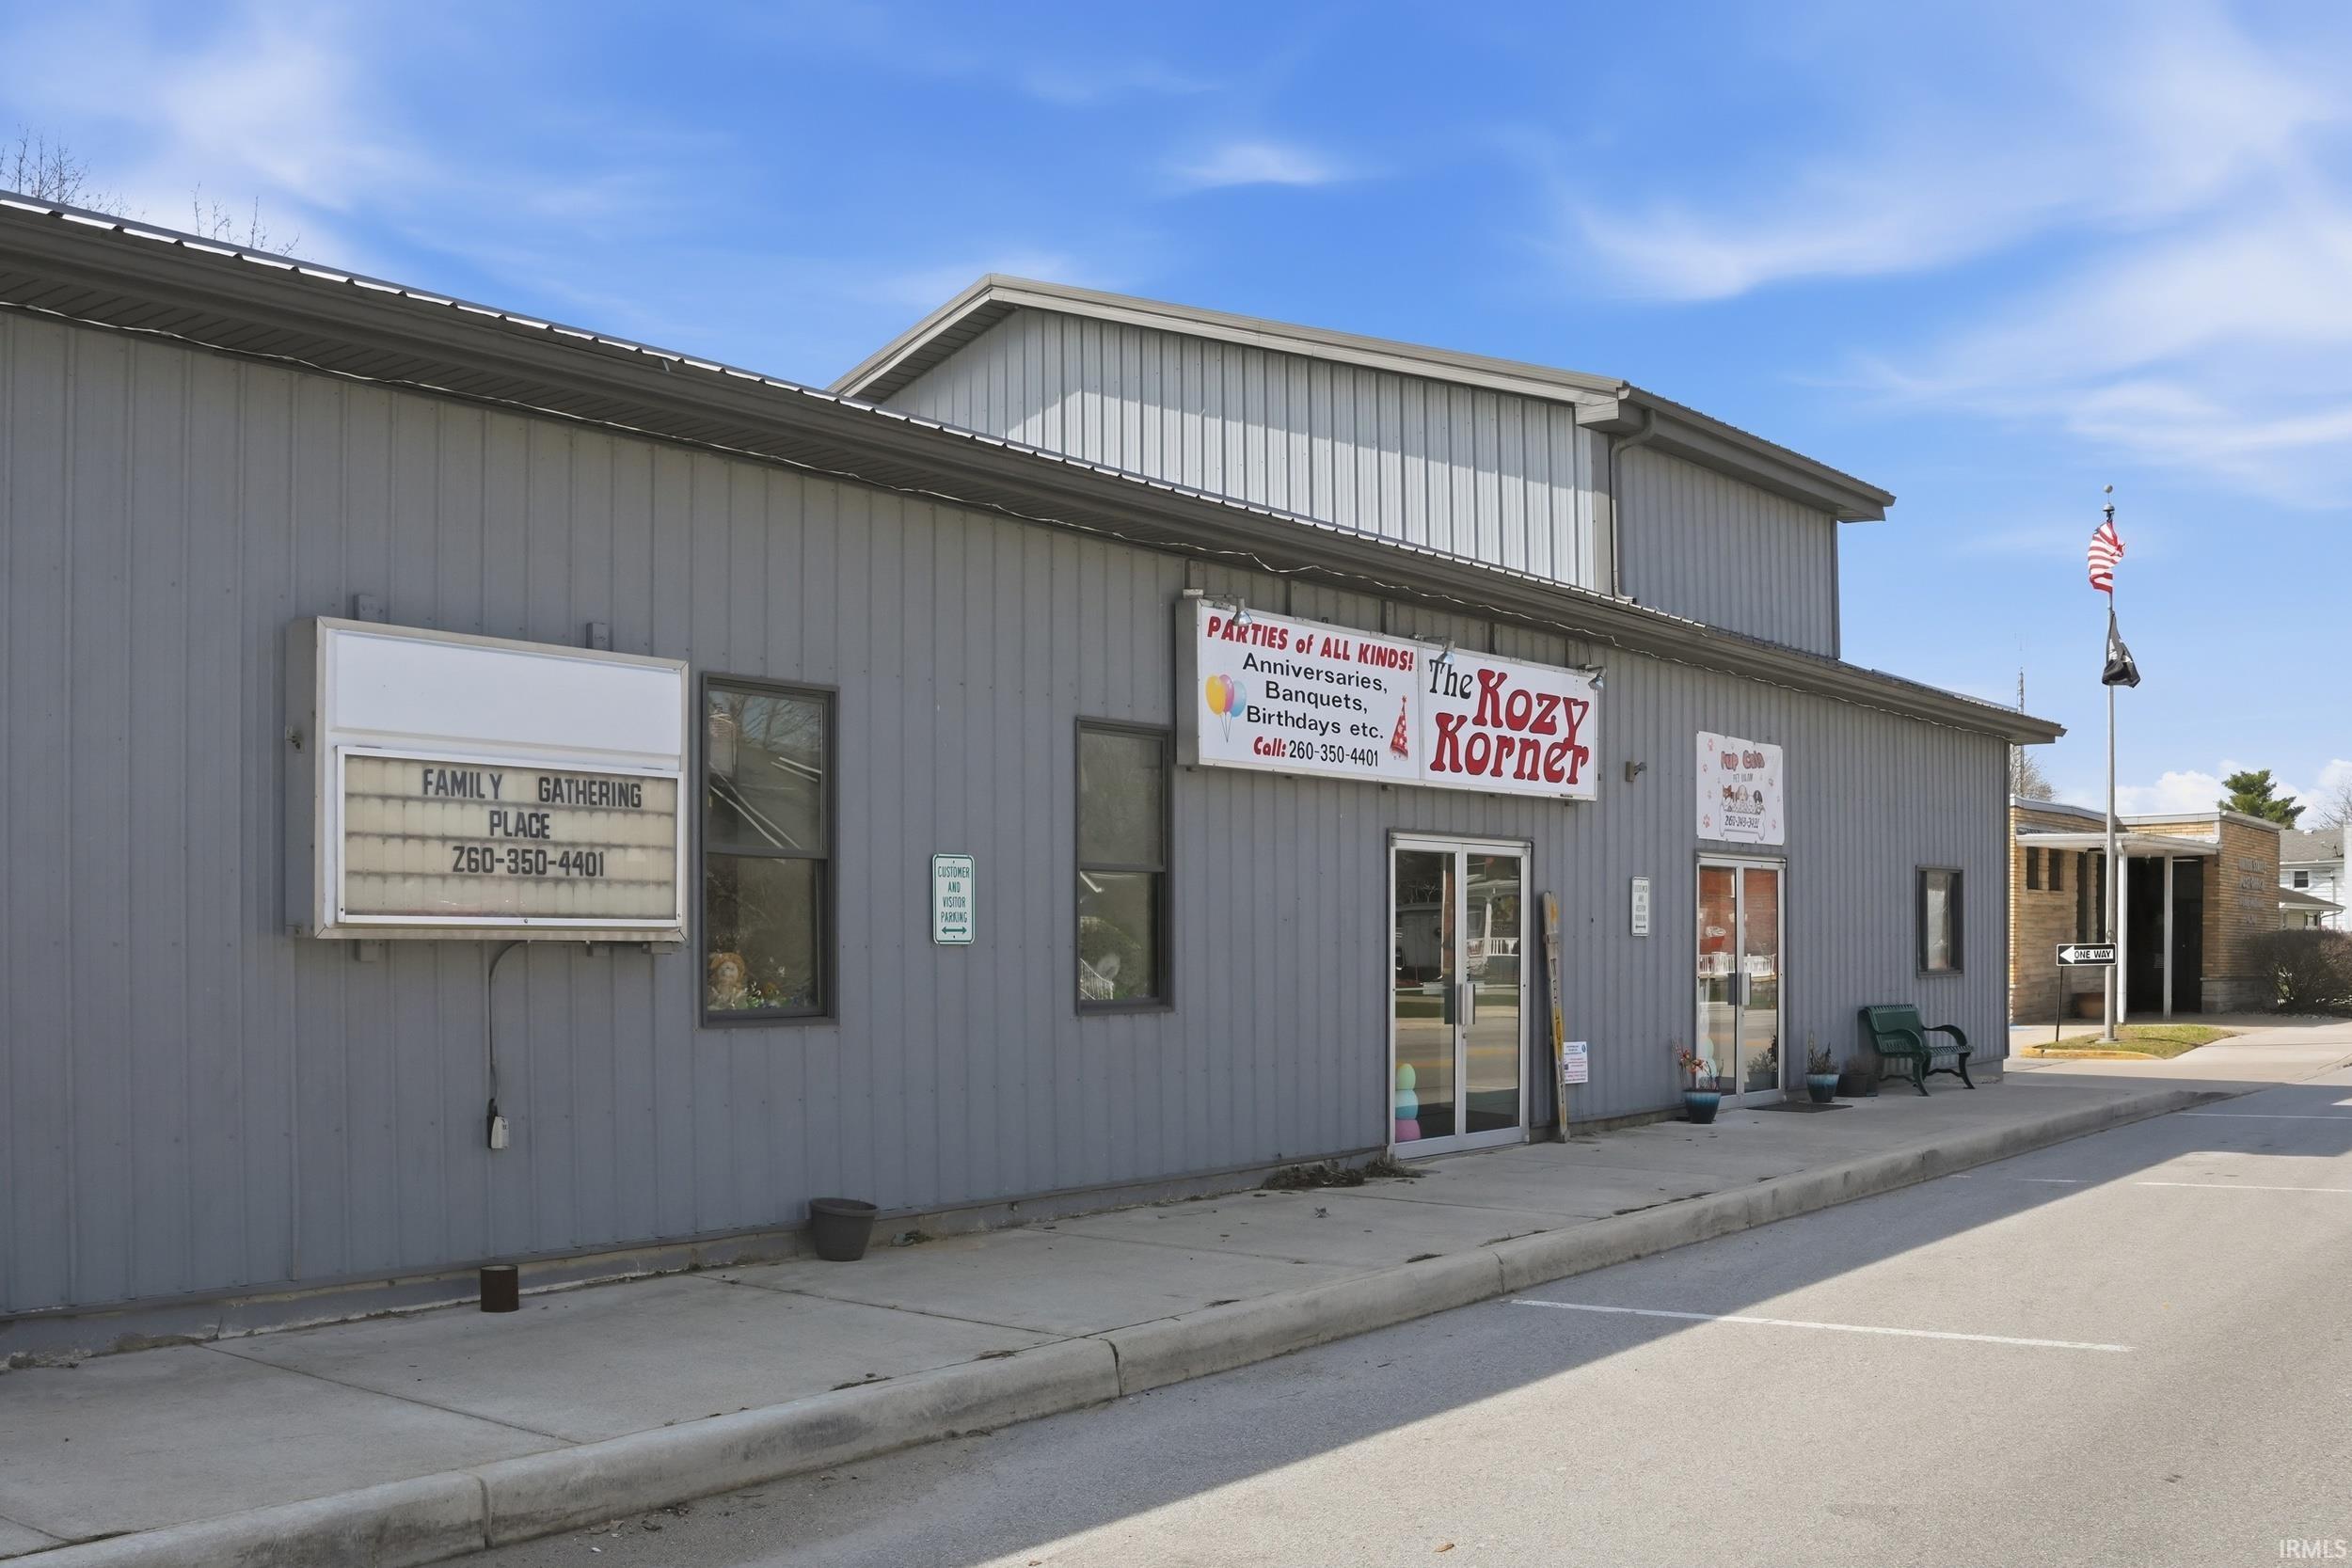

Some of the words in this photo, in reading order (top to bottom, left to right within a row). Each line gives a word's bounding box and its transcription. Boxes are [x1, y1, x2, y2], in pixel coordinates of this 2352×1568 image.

[1207, 616, 1289, 650] PARTIES
[1295, 634, 1314, 655] of
[1320, 637, 1351, 661] ALL
[1358, 643, 1415, 672] KINDS!
[1242, 652, 1389, 694] Anniversaries,
[1428, 658, 1474, 700] The
[1264, 680, 1369, 715] Banquets,
[1247, 705, 1342, 737] Birthdays
[1349, 722, 1385, 739] etc.
[1253, 736, 1287, 758] Call:
[1288, 739, 1379, 768] 260-350-4401
[1429, 711, 1590, 785] Korner
[422, 768, 503, 800] FAMILY
[537, 776, 643, 809] GATHERING
[489, 810, 551, 840] PLACE
[452, 846, 605, 878] 260-350-4401
[937, 865, 970, 879] CUSTOMER
[943, 896, 966, 908] VISITOR
[947, 881, 961, 894] AND
[941, 911, 968, 923] PARKING
[2074, 950, 2090, 959] ONE
[2093, 950, 2111, 958] WAY
